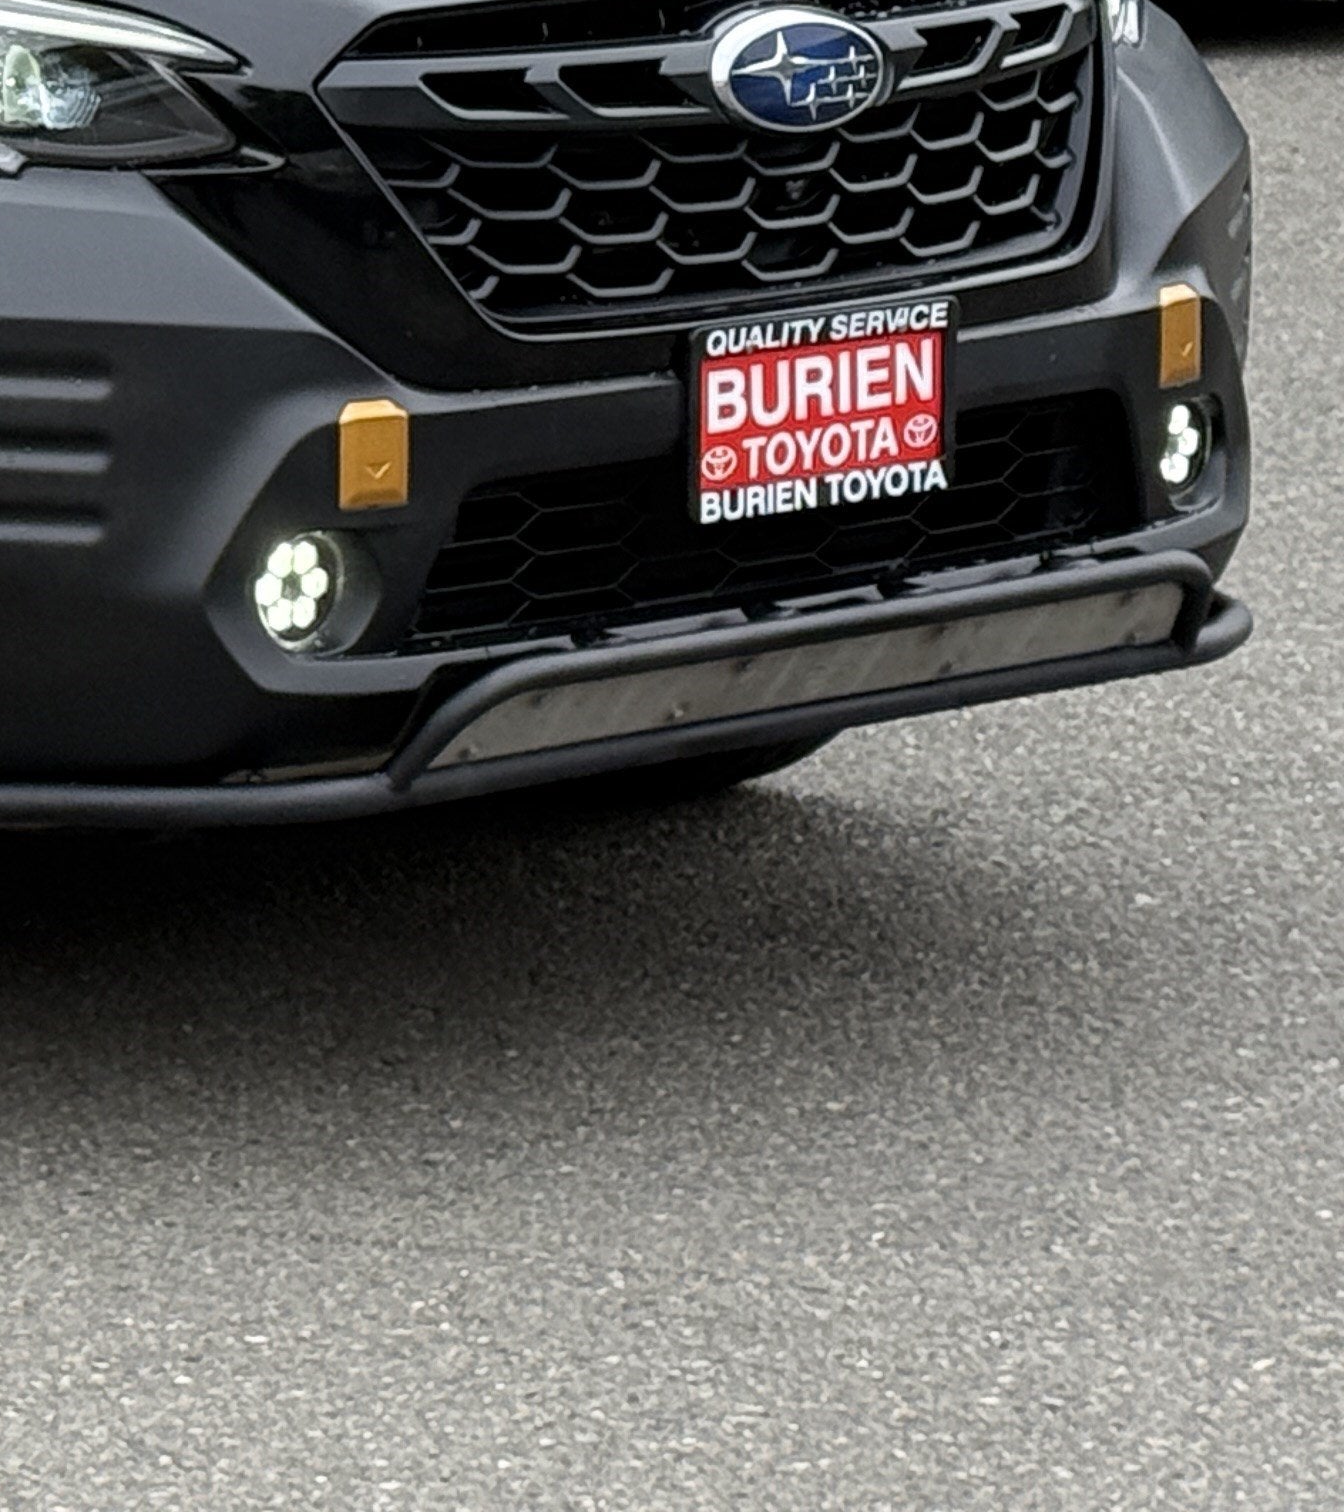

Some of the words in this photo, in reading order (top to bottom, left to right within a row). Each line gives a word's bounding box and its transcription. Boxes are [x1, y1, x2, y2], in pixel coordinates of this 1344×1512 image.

[706, 317, 827, 357] QUALITY
[829, 302, 949, 341] SERVICE
[707, 338, 935, 435] BURIEN
[741, 416, 900, 478] TOYOTA
[700, 477, 818, 525] BURIEN
[824, 459, 949, 506] TOYOTA
